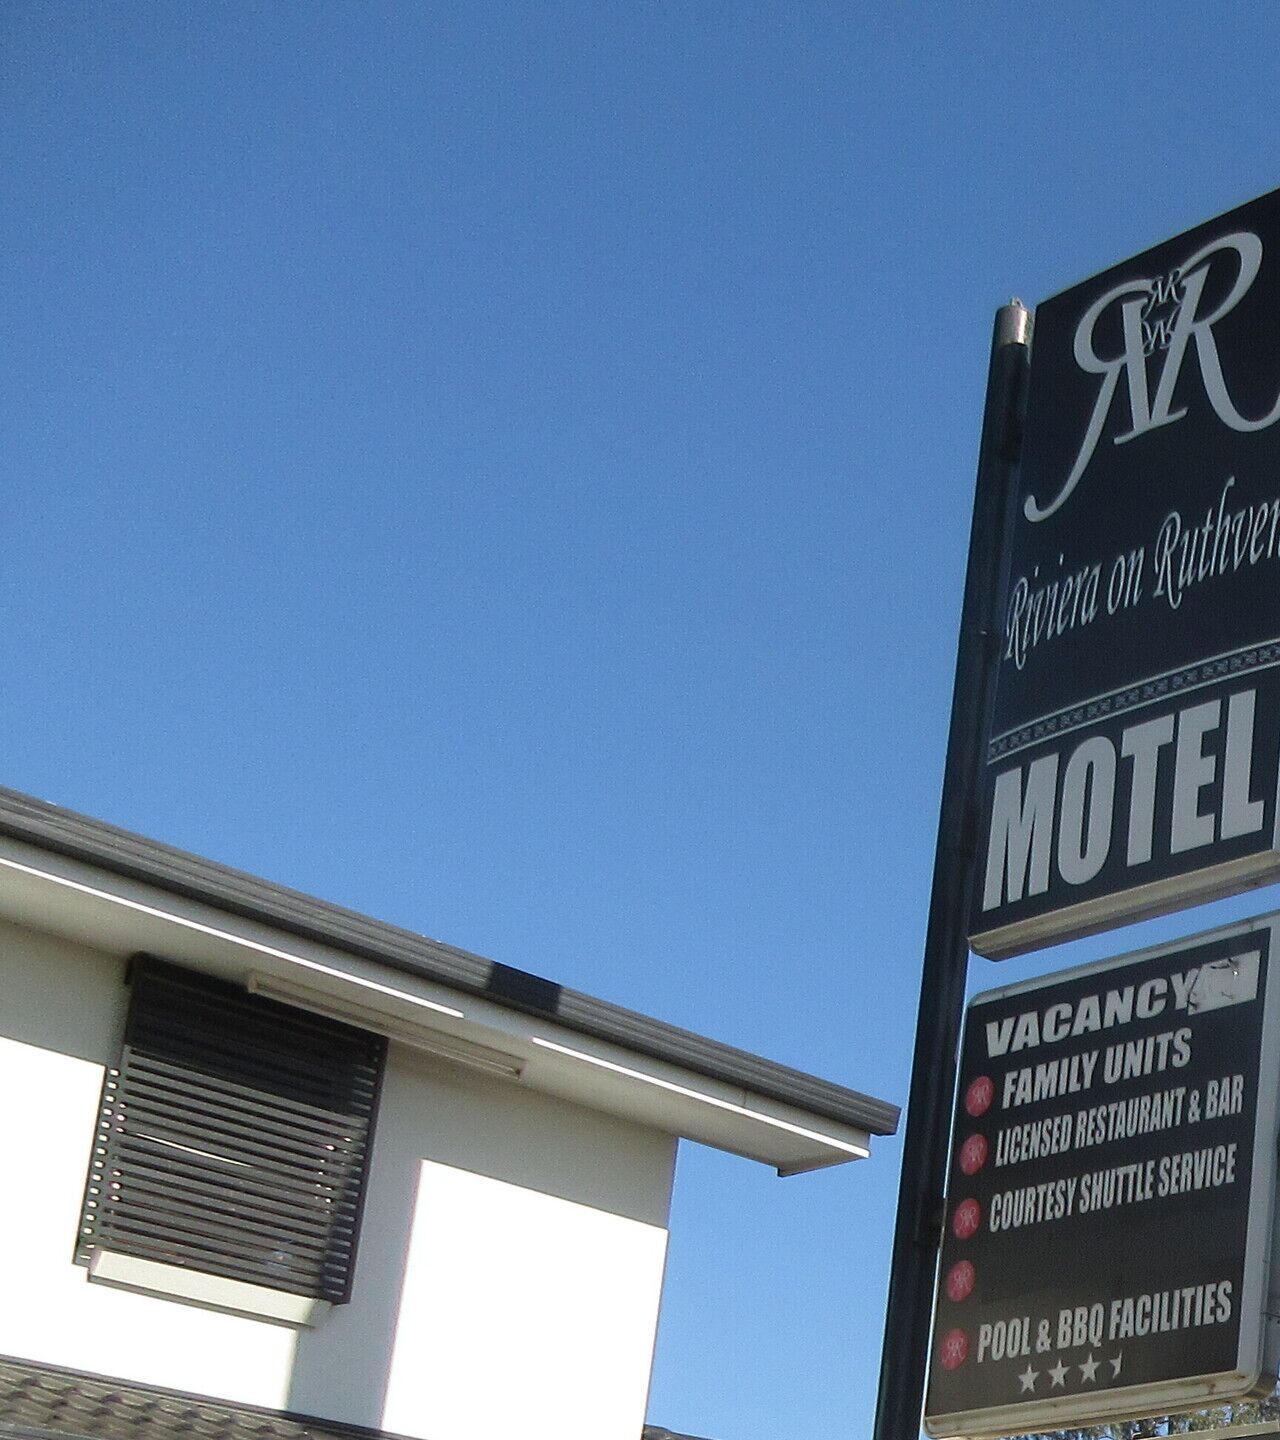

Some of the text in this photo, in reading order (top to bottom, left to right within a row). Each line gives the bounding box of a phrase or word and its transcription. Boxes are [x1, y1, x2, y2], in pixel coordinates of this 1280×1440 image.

[1005, 553, 1098, 671] Riviera
[1111, 541, 1146, 617] on
[983, 689, 1265, 912] MOTEL
[985, 968, 1200, 1058] VACANCY
[1002, 1027, 1192, 1109] FAMILY UNITS
[995, 1074, 1244, 1167] LICENSED RESTAURANT & BAR
[989, 1143, 1237, 1233] COURTESY SHUTTLE SERVICE
[977, 1280, 1232, 1363] POOL & BBQ FACILITIES
